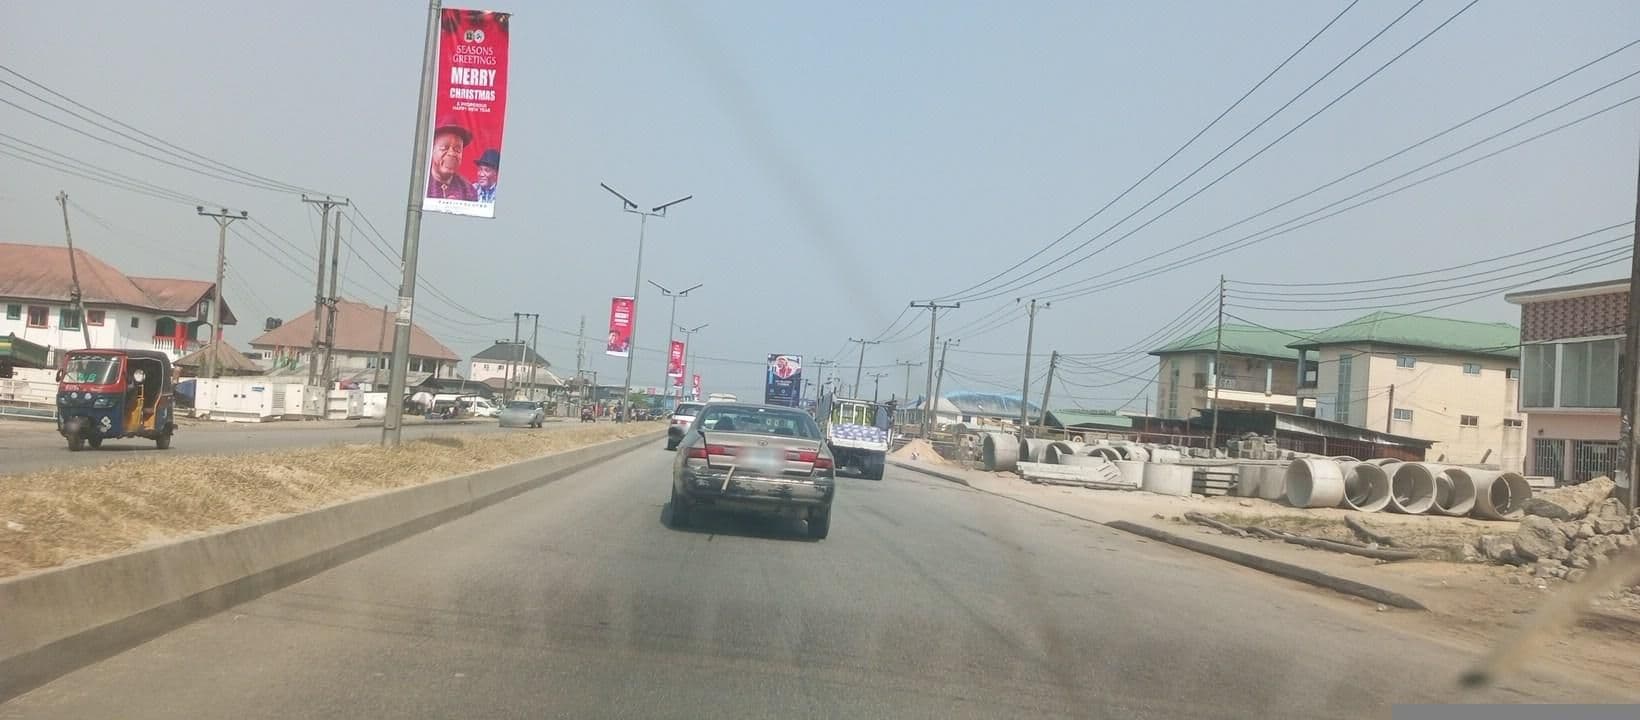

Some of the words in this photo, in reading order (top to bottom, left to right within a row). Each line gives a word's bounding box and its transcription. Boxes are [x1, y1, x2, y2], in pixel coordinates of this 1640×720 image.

[456, 45, 493, 55] SEASONS
[452, 54, 496, 65] GREETINGS
[451, 67, 496, 87] MERRY
[449, 88, 496, 101] CHRISTMAS
